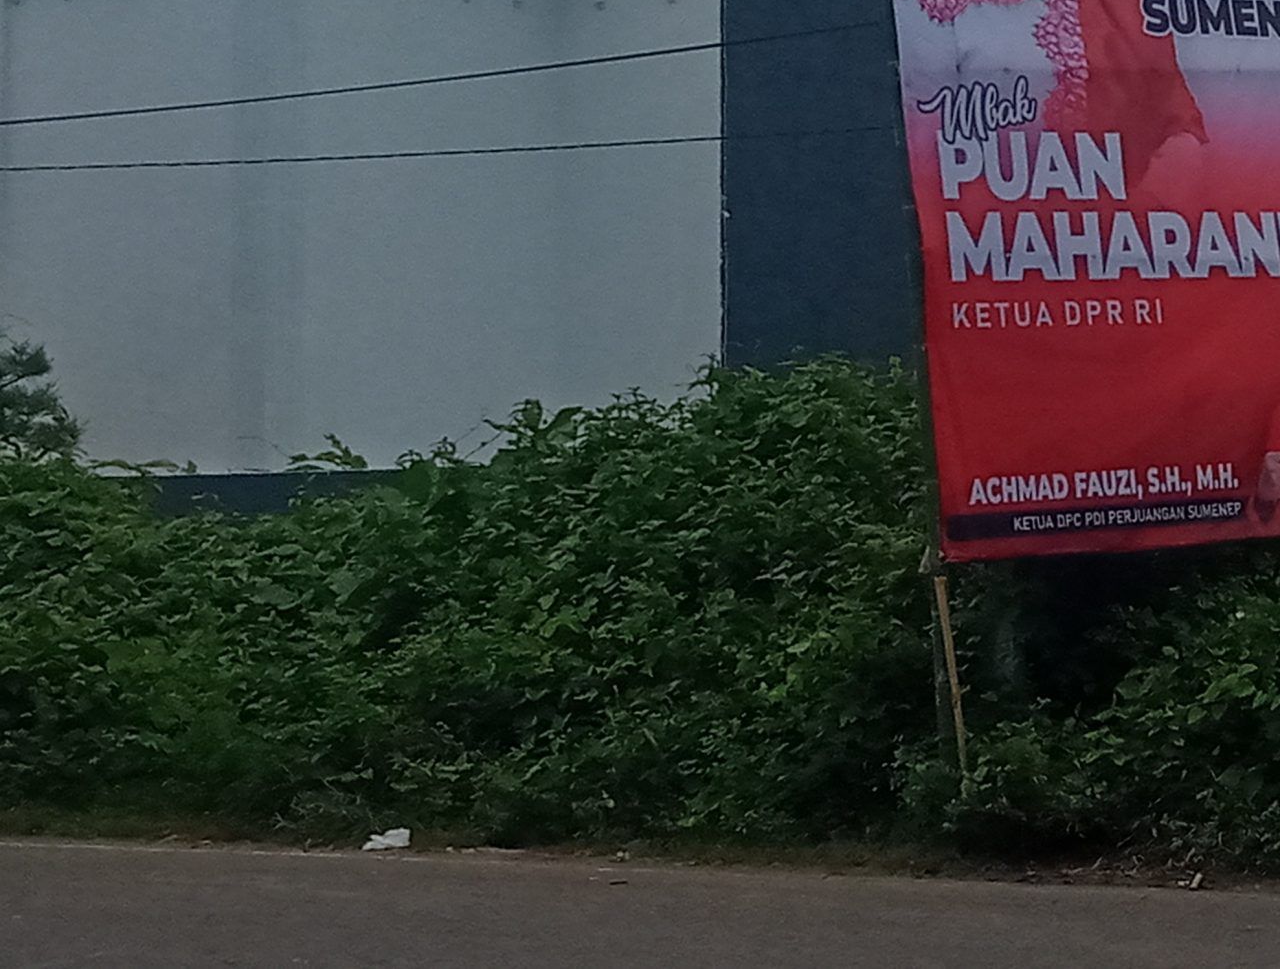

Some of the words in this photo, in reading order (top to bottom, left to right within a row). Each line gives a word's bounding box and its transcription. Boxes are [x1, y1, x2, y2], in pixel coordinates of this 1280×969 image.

[917, 75, 1037, 143] Mbak
[937, 129, 1127, 201] PUAN
[952, 301, 1054, 328] KETUA
[1064, 300, 1124, 326] DPR
[1135, 298, 1163, 325] RI
[969, 472, 1069, 506] ACHMAD
[1074, 468, 1143, 500] FAUZI,
[1147, 466, 1192, 496] S.H.,
[1195, 463, 1239, 491] M.H.
[1013, 514, 1054, 531] KETUA
[1056, 512, 1082, 529] DPC
[1085, 511, 1106, 527] PDI
[1108, 505, 1185, 525] PERJUANGAN
[1188, 502, 1242, 519] SUMENEP
